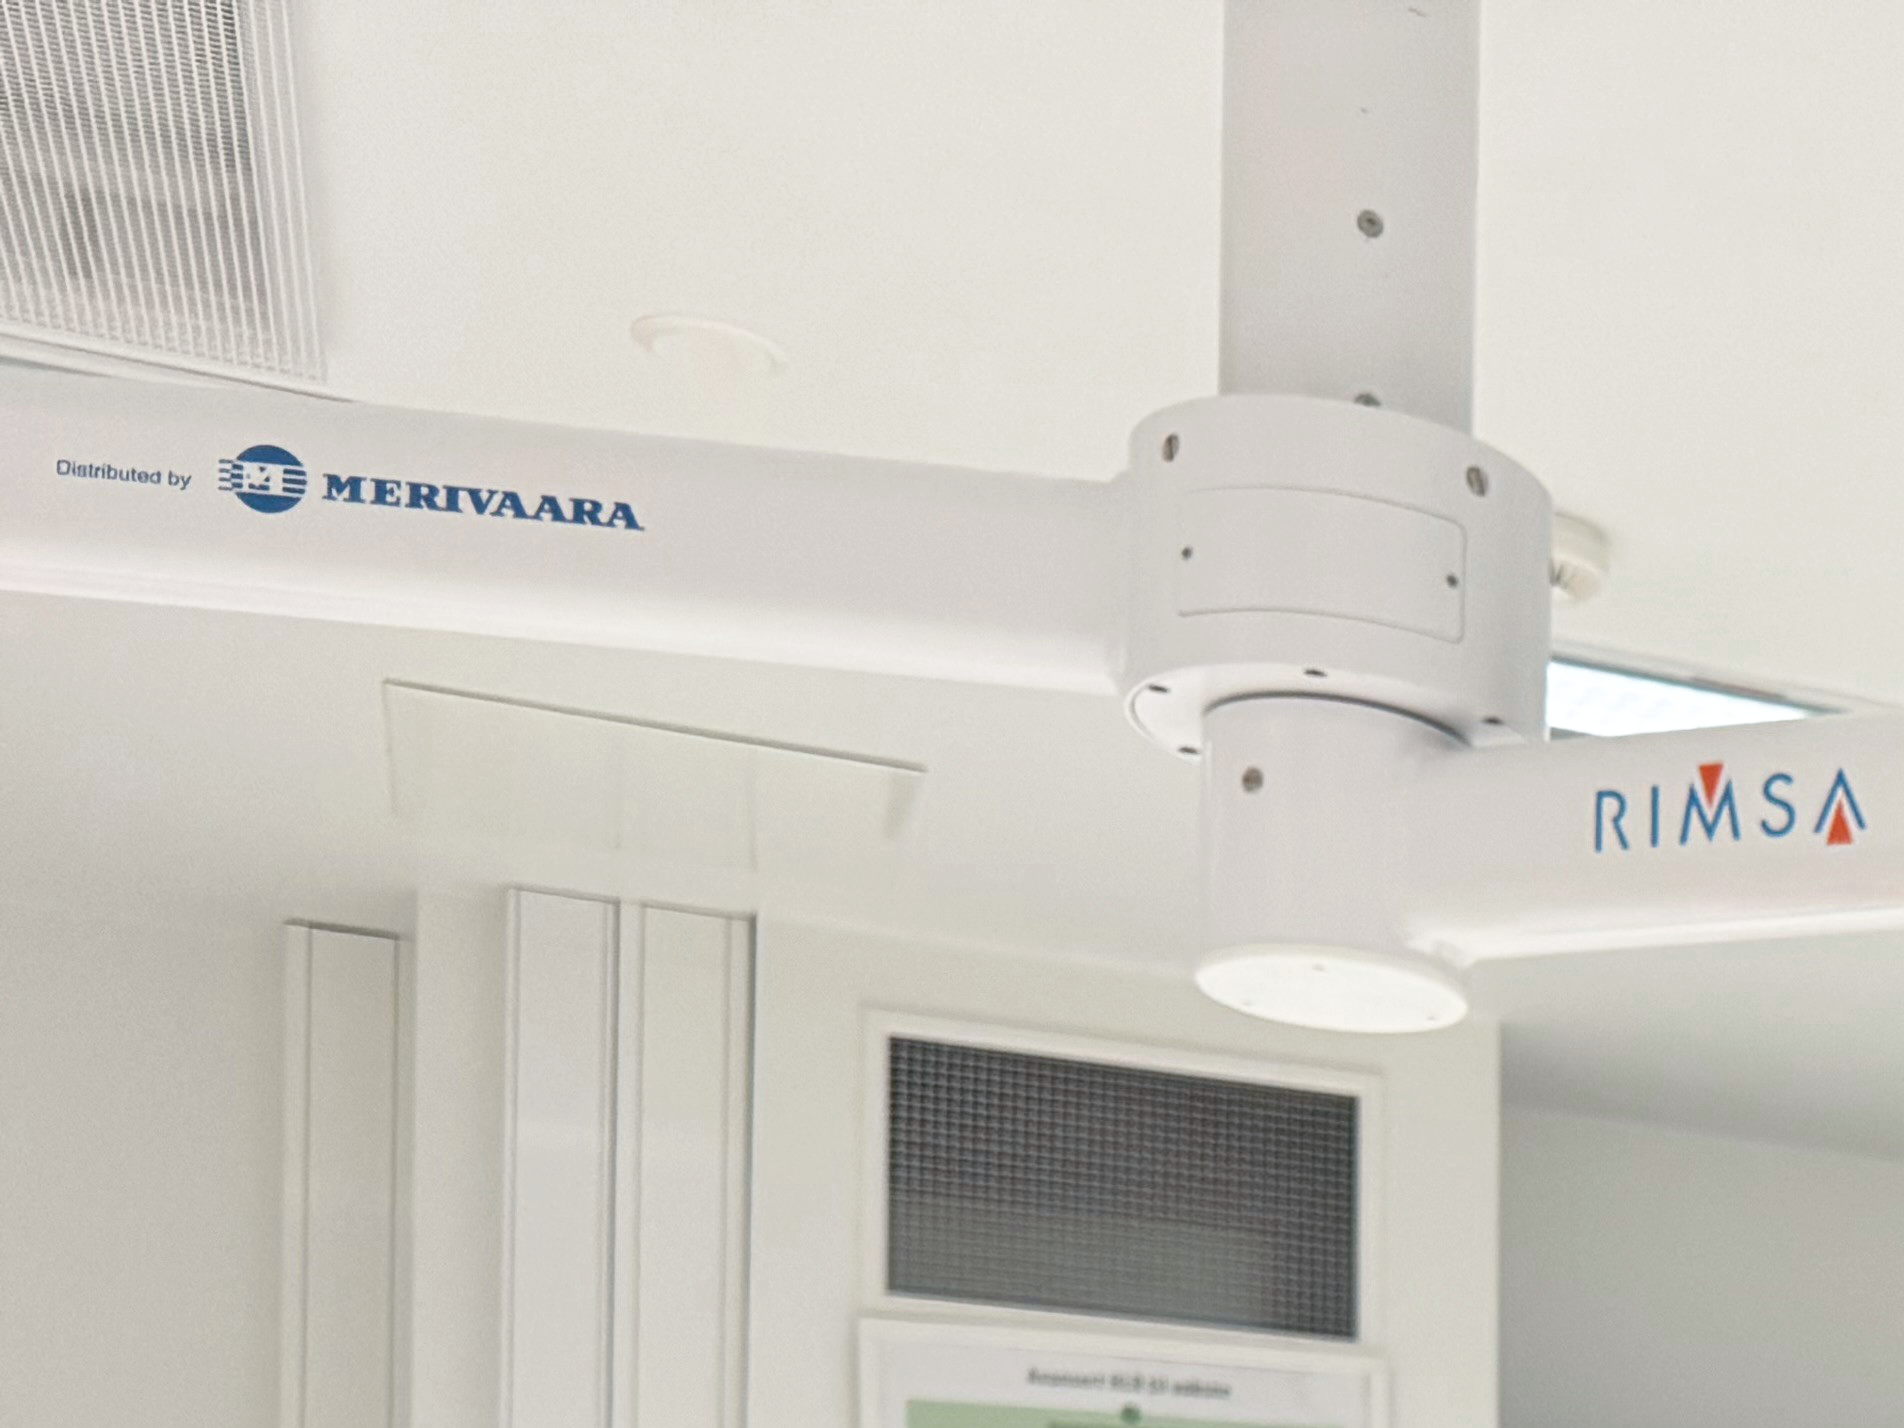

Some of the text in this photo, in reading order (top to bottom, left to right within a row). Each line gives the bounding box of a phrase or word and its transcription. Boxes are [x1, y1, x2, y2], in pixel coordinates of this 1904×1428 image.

[56, 458, 162, 486] Distributed
[168, 470, 192, 490] by
[322, 473, 645, 532] MERIVAARA
[1594, 761, 1868, 853] RIMSA
